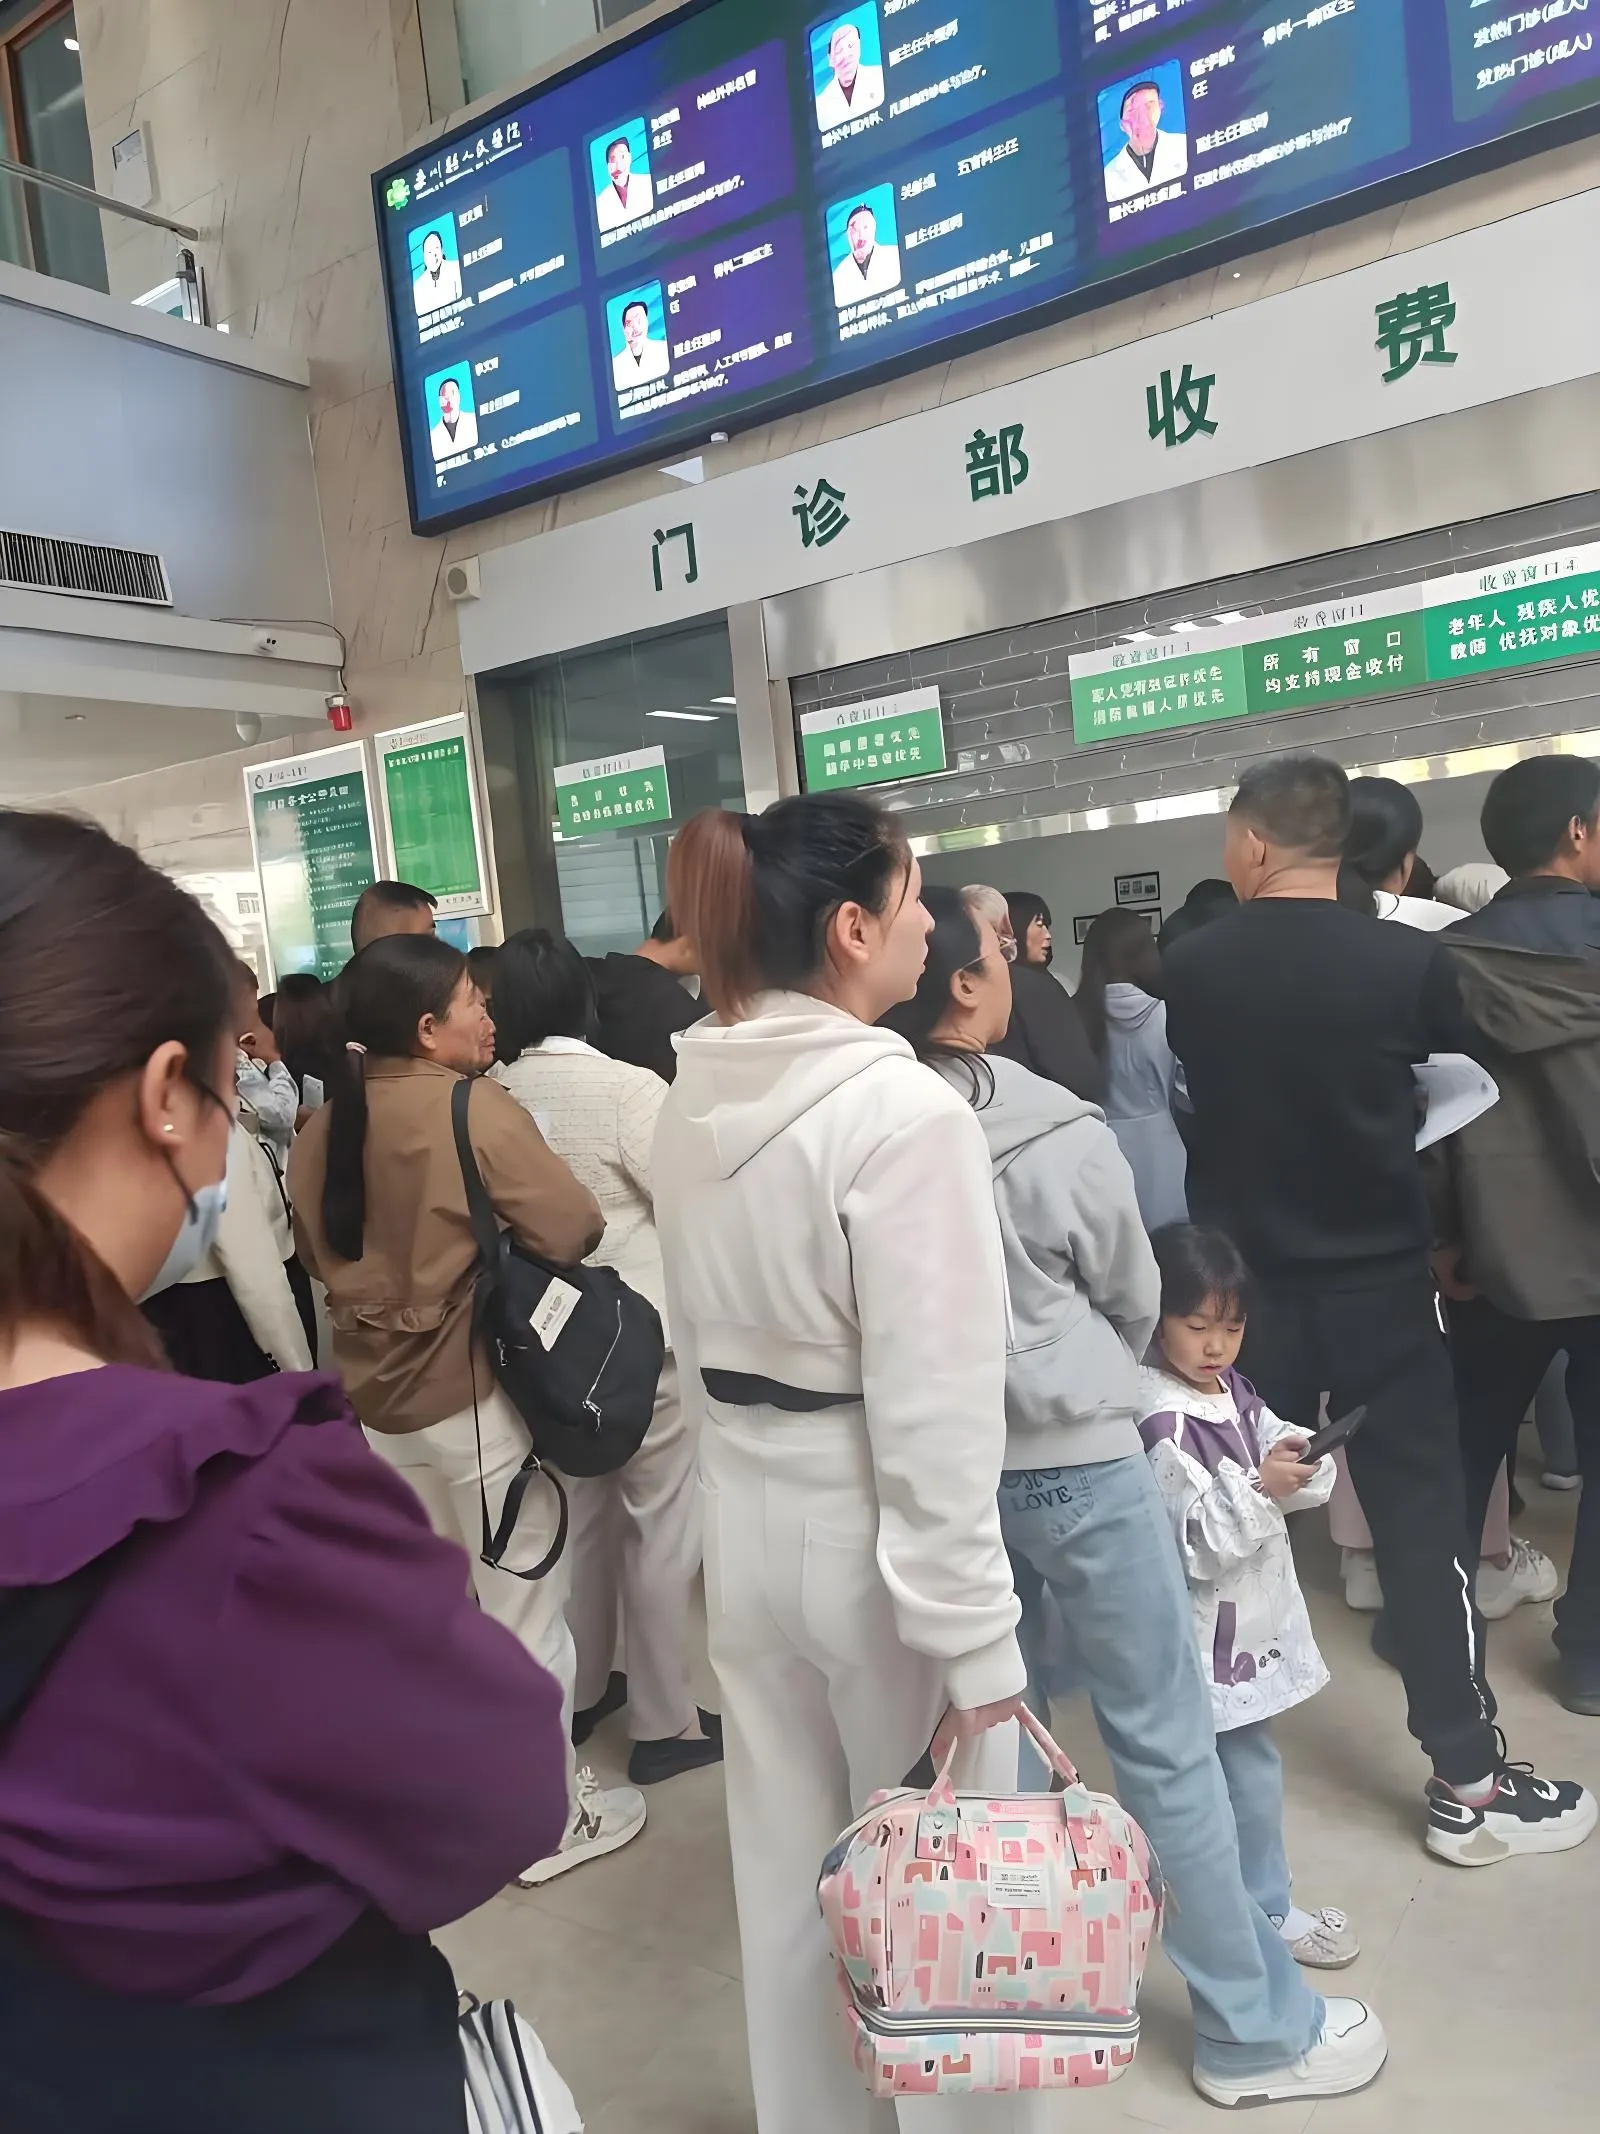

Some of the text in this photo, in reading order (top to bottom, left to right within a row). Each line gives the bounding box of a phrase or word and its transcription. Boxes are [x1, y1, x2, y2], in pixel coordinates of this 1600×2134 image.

[1448, 609, 1506, 636] 老年人
[1264, 654, 1404, 694] 均支持现金收付
[1011, 1485, 1073, 1512] LOVE
